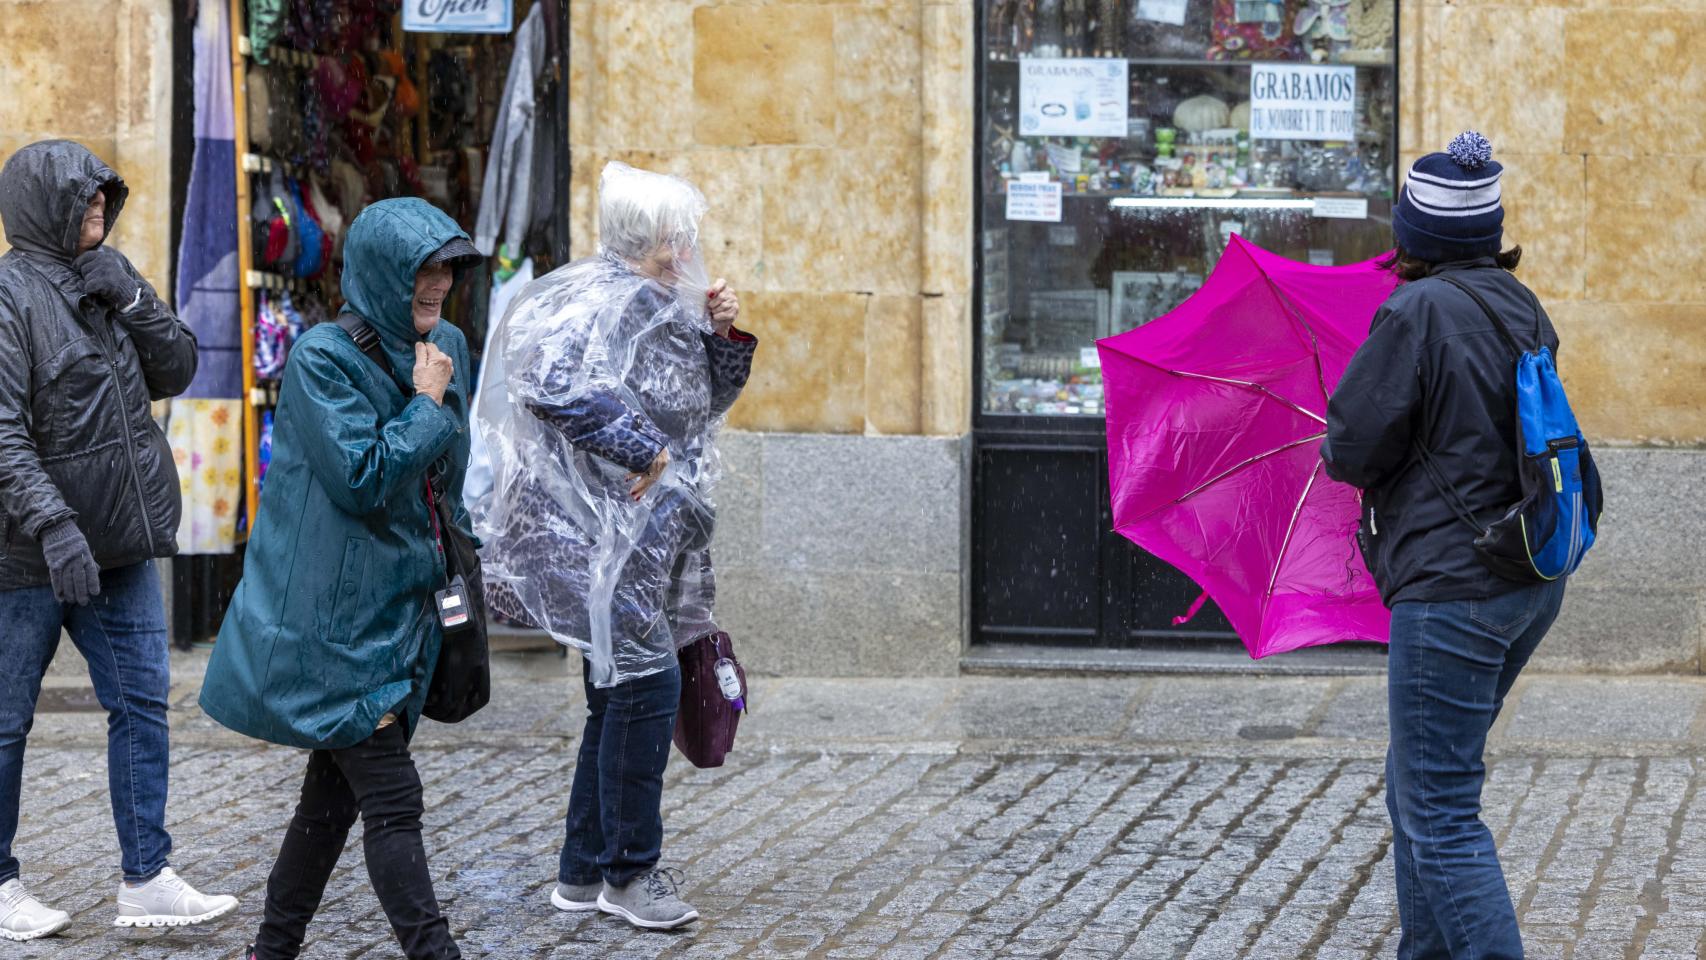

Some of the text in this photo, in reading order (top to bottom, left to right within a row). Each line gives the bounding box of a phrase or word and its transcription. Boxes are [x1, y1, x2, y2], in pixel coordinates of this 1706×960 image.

[417, 0, 488, 23] Open
[1254, 72, 1352, 101] GRABAMOS
[1253, 108, 1263, 130] TU
[1268, 109, 1303, 131] NOMBRE
[1315, 110, 1325, 132] TU
[1330, 110, 1353, 133] FOTO
